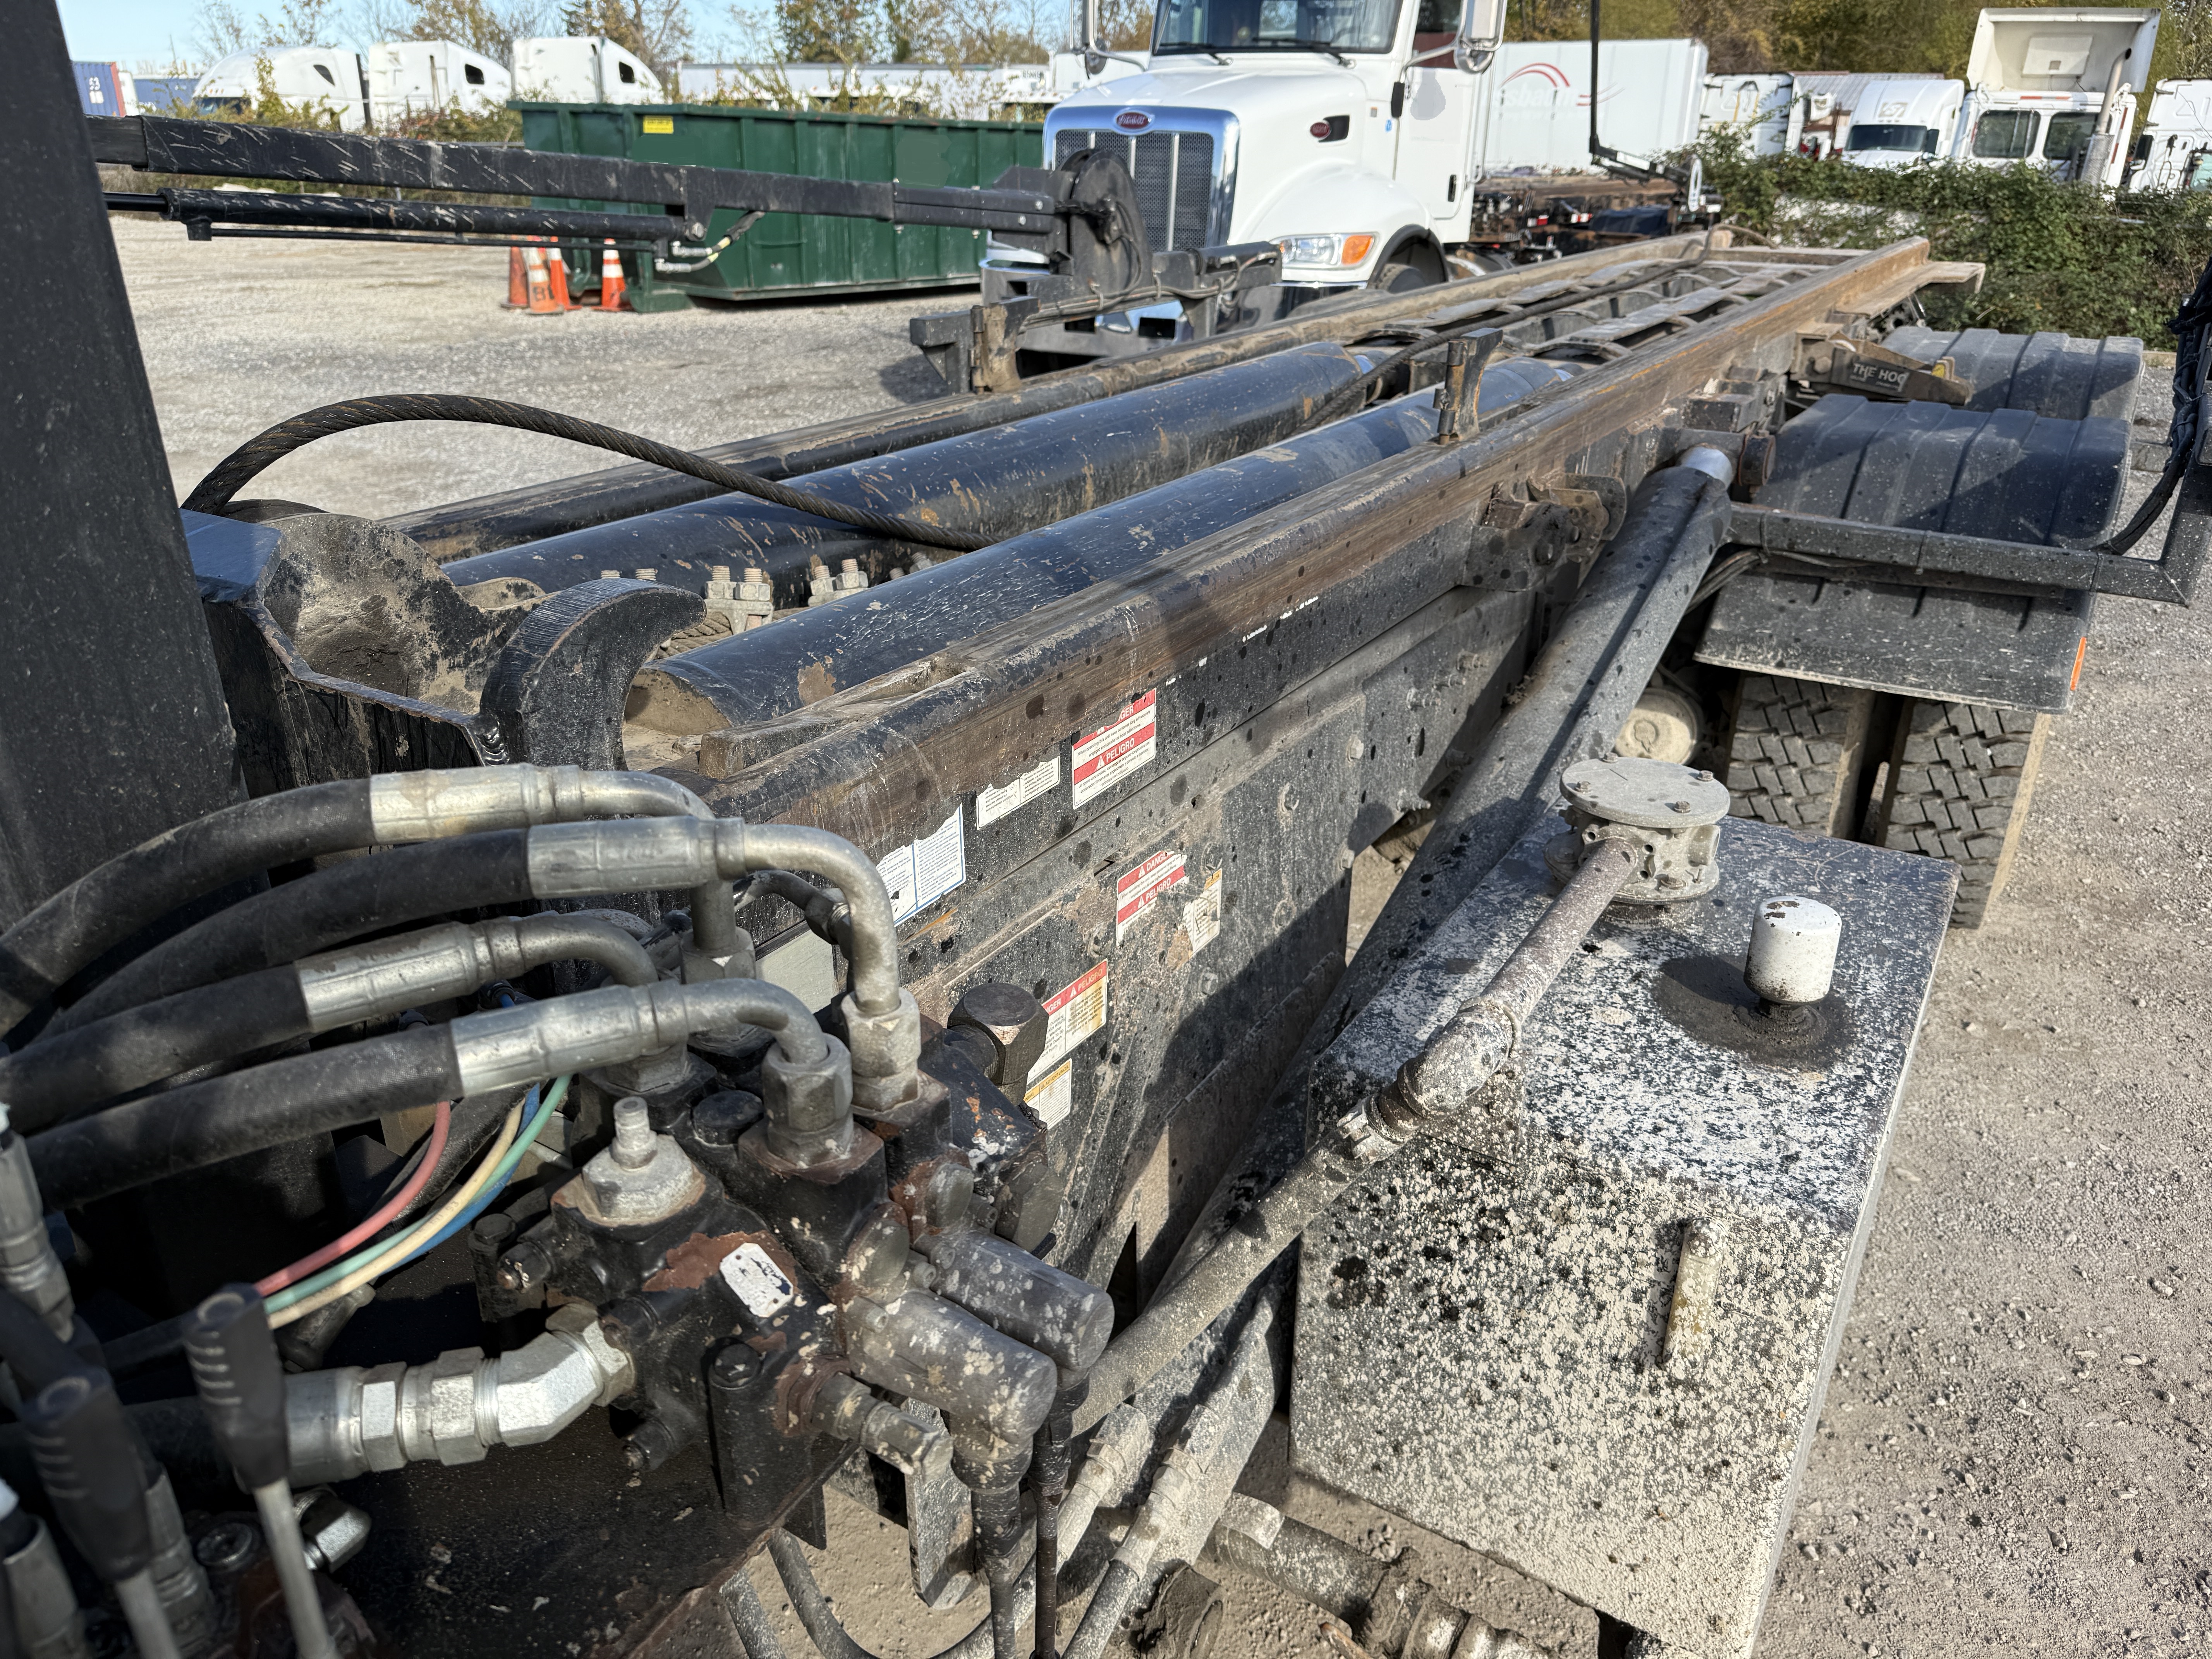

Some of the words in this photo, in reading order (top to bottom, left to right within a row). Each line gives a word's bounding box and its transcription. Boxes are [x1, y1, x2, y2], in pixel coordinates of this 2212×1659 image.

[1120, 704, 1134, 720] GER
[1106, 737, 1135, 763] PELIGRO
[1147, 852, 1168, 872] DANGE
[1146, 878, 1171, 902] PELIGRO
[1078, 968, 1103, 992] PELIGRO
